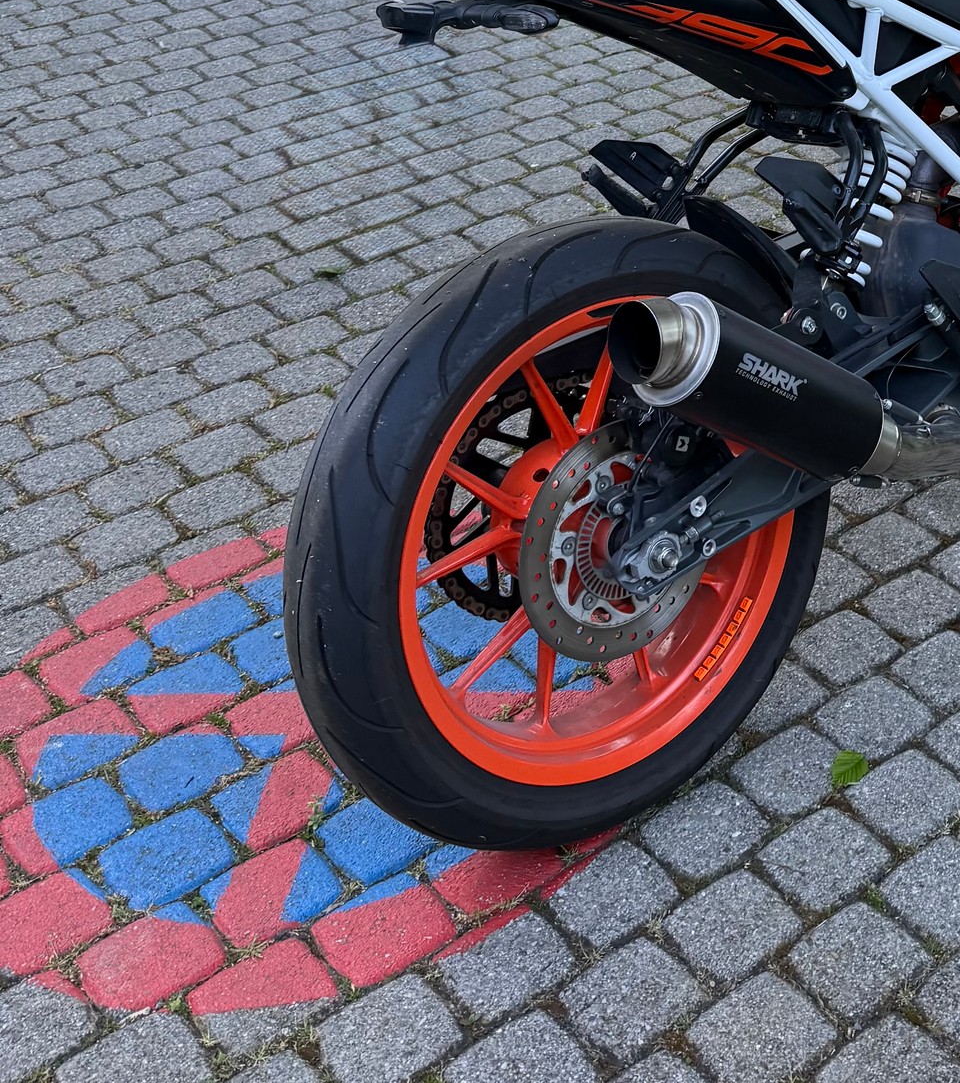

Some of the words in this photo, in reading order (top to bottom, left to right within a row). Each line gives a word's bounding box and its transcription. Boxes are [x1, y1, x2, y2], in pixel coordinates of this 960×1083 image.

[735, 368, 771, 389] TECHNOLOGY
[771, 385, 798, 402] EXHAUST
[738, 352, 803, 396] SHARK
